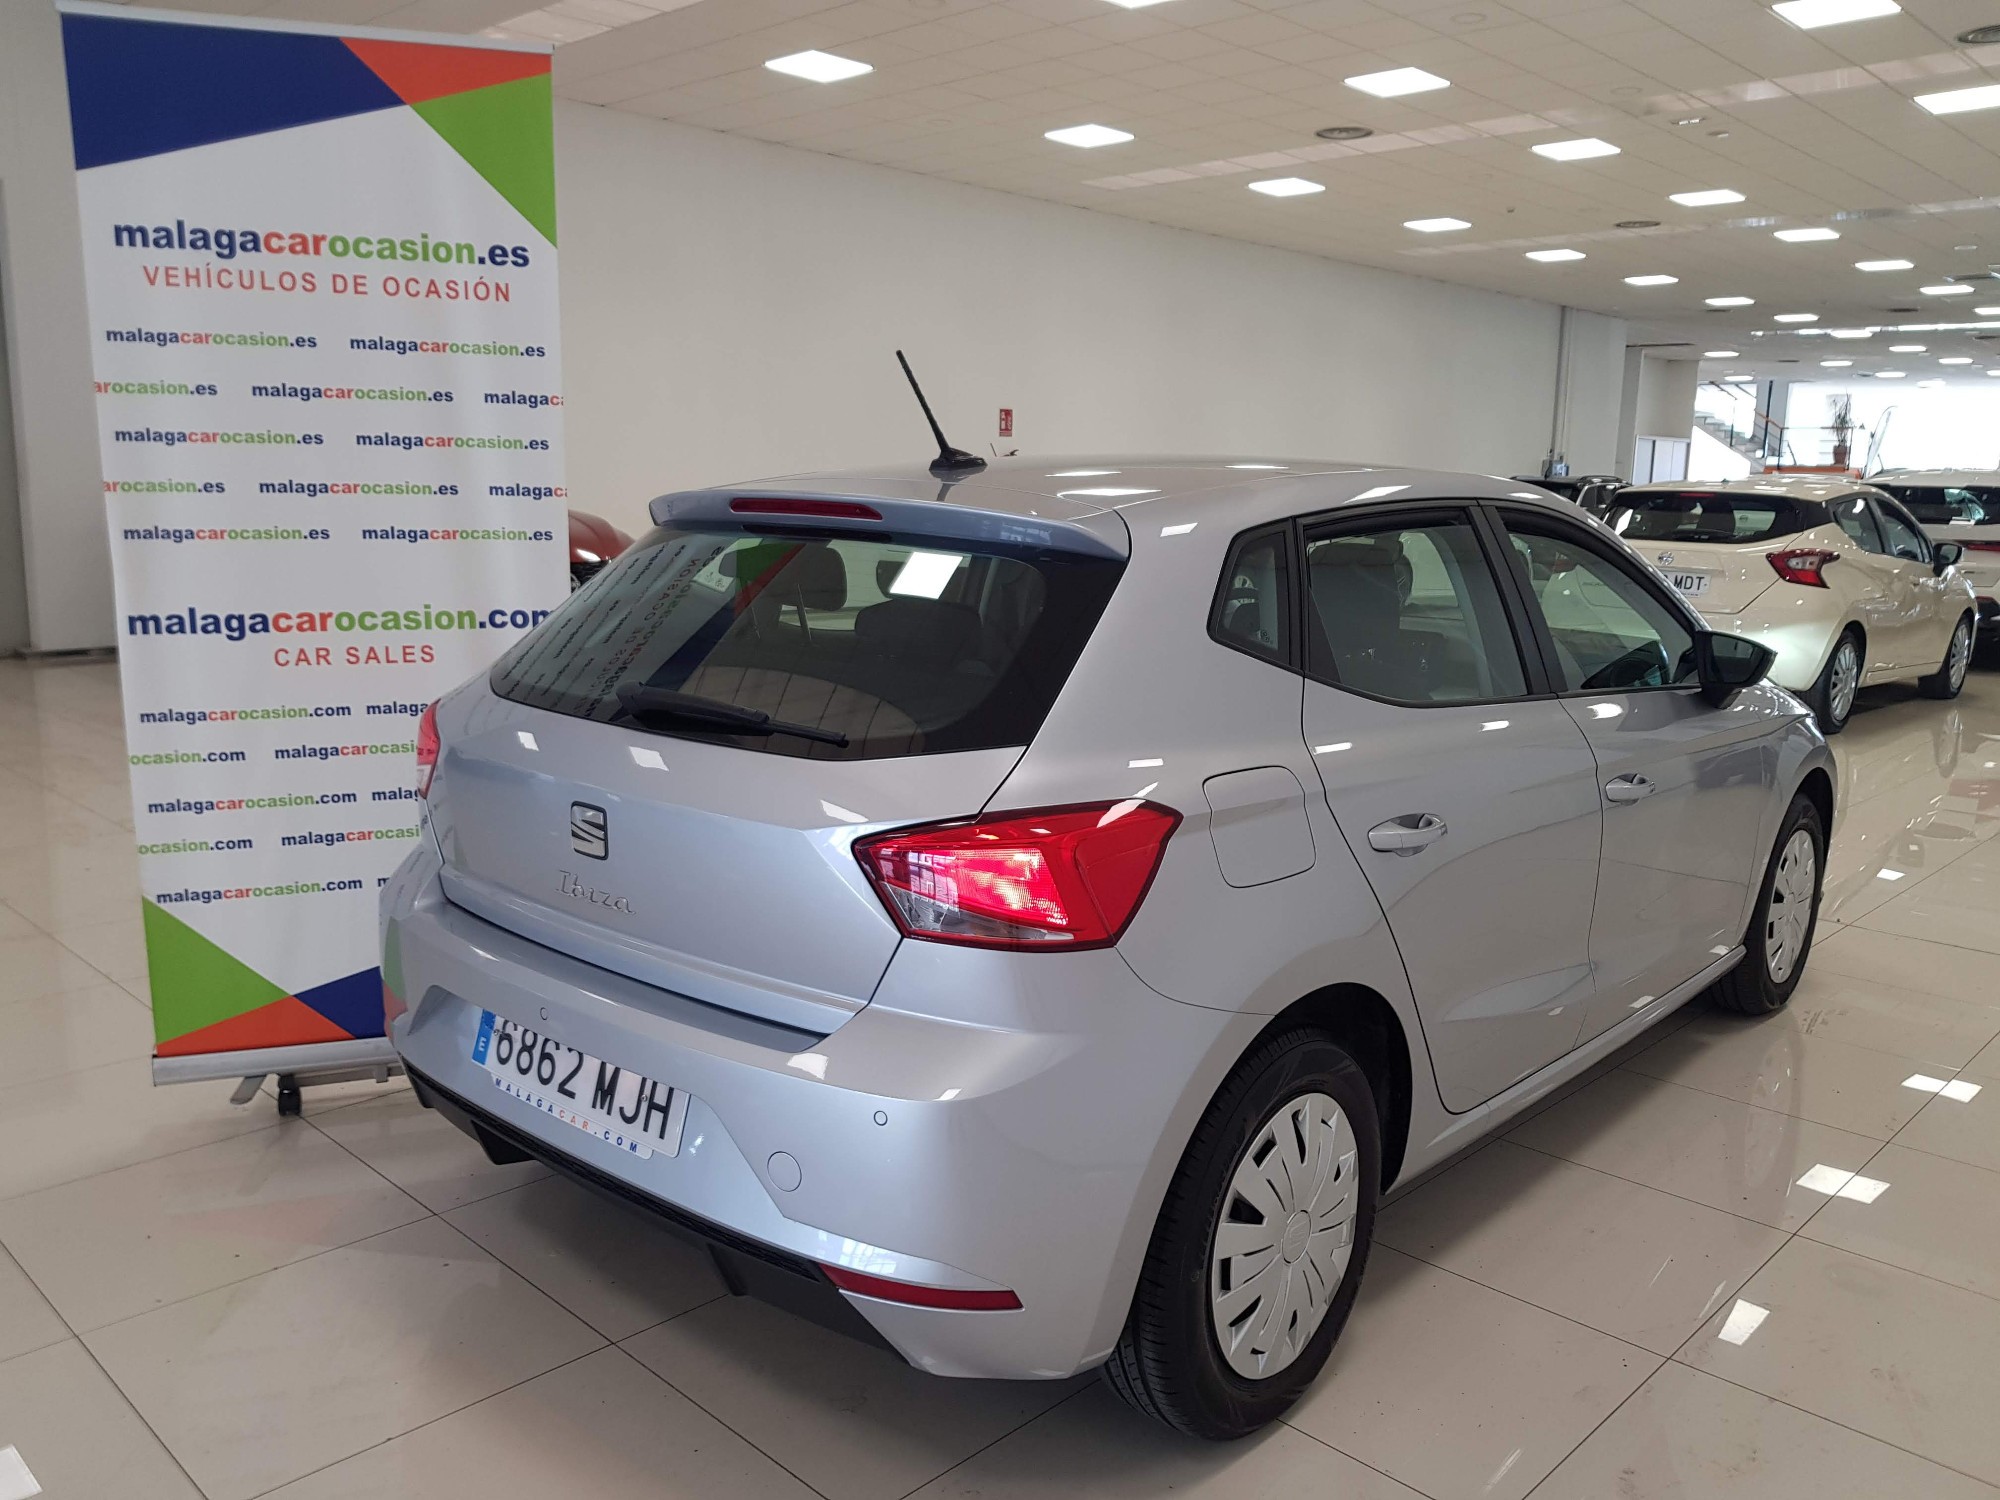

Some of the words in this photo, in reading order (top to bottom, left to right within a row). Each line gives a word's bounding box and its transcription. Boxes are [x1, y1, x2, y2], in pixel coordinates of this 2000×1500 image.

[113, 219, 530, 268] malagacarocasion.es
[143, 265, 316, 292] VEHÍCULOS
[332, 274, 368, 295] DE
[383, 276, 509, 302] OCASIÓN
[106, 328, 317, 348] malagacarocasion.es
[350, 336, 545, 357] malagacarocasion.es
[252, 383, 454, 402] malagacarocasion.es
[115, 428, 324, 446] malagacarocasion.es
[356, 432, 549, 450] malagacarocasion.es
[103, 479, 225, 495] arocasion.es
[259, 479, 459, 497] malagacarocasion.es
[123, 525, 330, 543] malagacarocasion.es
[362, 526, 553, 543] malagacarocasion.es
[1674, 575, 1706, 590] MDT
[274, 647, 332, 667] CAR
[346, 645, 434, 664] SALES
[140, 703, 351, 725] malagacarocasion.com
[130, 750, 246, 765] ocasion.com
[275, 741, 418, 761] malagacarocasi
[148, 791, 357, 814] malagacarocasion.com
[137, 839, 253, 854] ocasion.com
[156, 880, 363, 907] malagacarocasion.com
[556, 869, 636, 915] Ibiza
[479, 1036, 487, 1052] E
[496, 1019, 584, 1100] 6862
[591, 1060, 685, 1140] MJH
